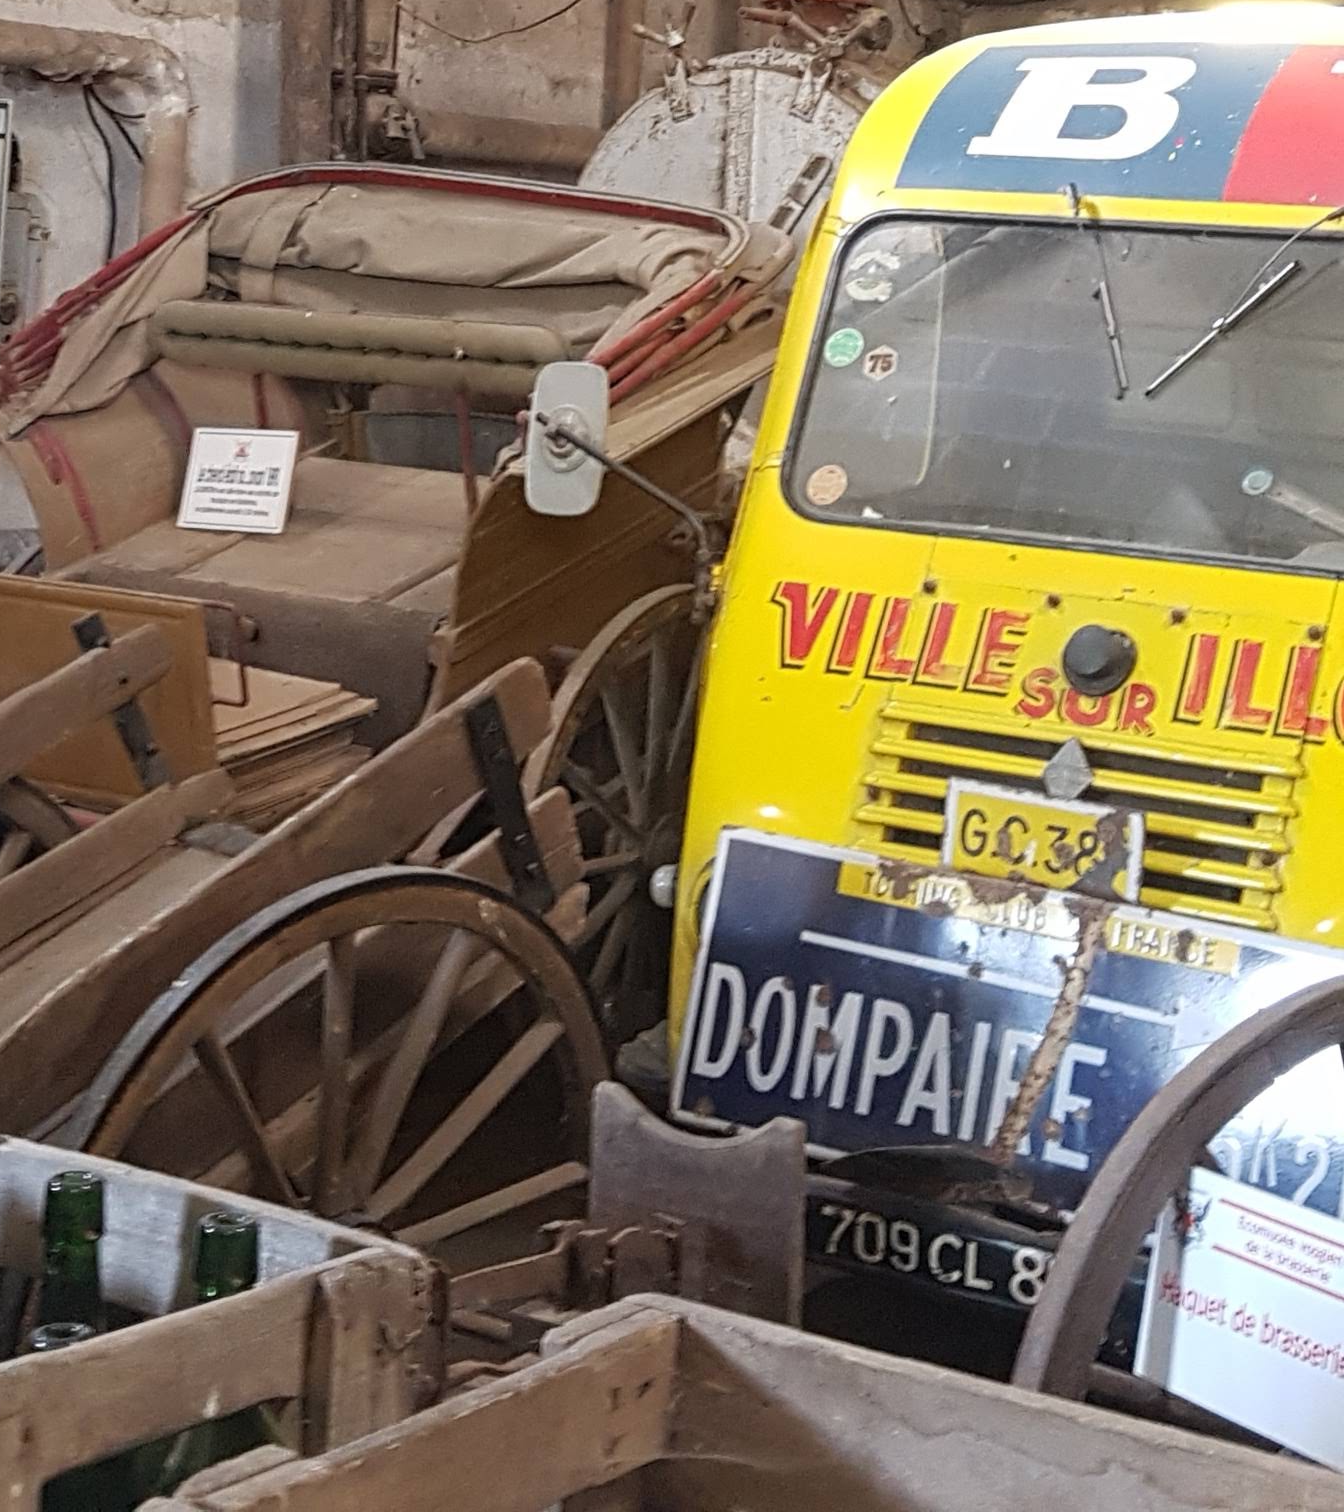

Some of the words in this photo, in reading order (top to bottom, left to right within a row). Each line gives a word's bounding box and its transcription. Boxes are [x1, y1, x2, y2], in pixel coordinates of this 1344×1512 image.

[867, 353, 894, 373] 75
[772, 582, 1032, 697] VILLE
[1017, 667, 1155, 736] SUR
[692, 961, 1109, 1171] DOMPAIRE
[820, 1203, 920, 1273] 709
[928, 1233, 994, 1291] CL
[1009, 1246, 1055, 1306] 8
[1232, 1303, 1256, 1338] de
